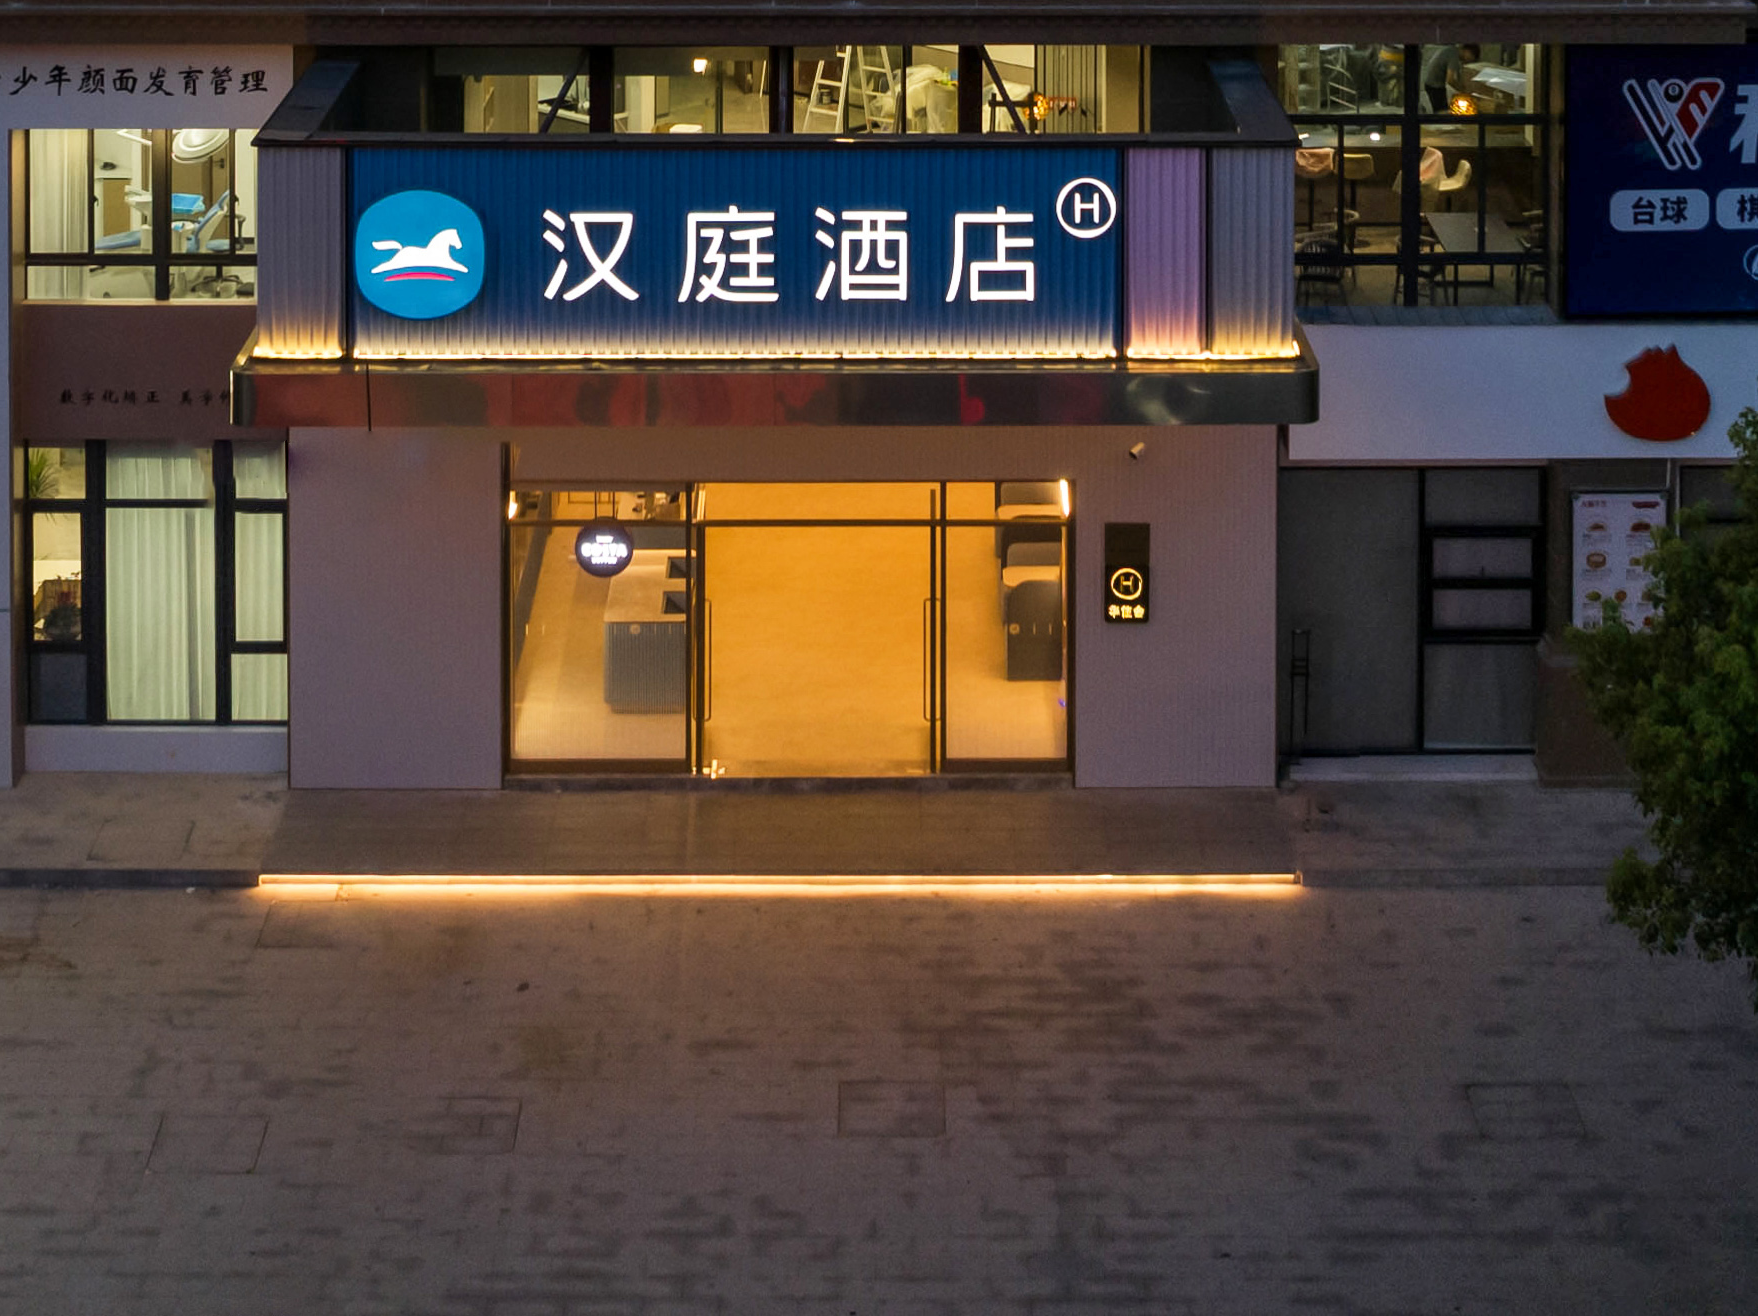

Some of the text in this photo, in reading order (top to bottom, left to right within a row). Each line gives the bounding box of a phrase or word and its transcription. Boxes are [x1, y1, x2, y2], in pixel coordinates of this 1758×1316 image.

[1631, 196, 1688, 225] 台球
[542, 204, 1036, 304] 汉庭酒店
